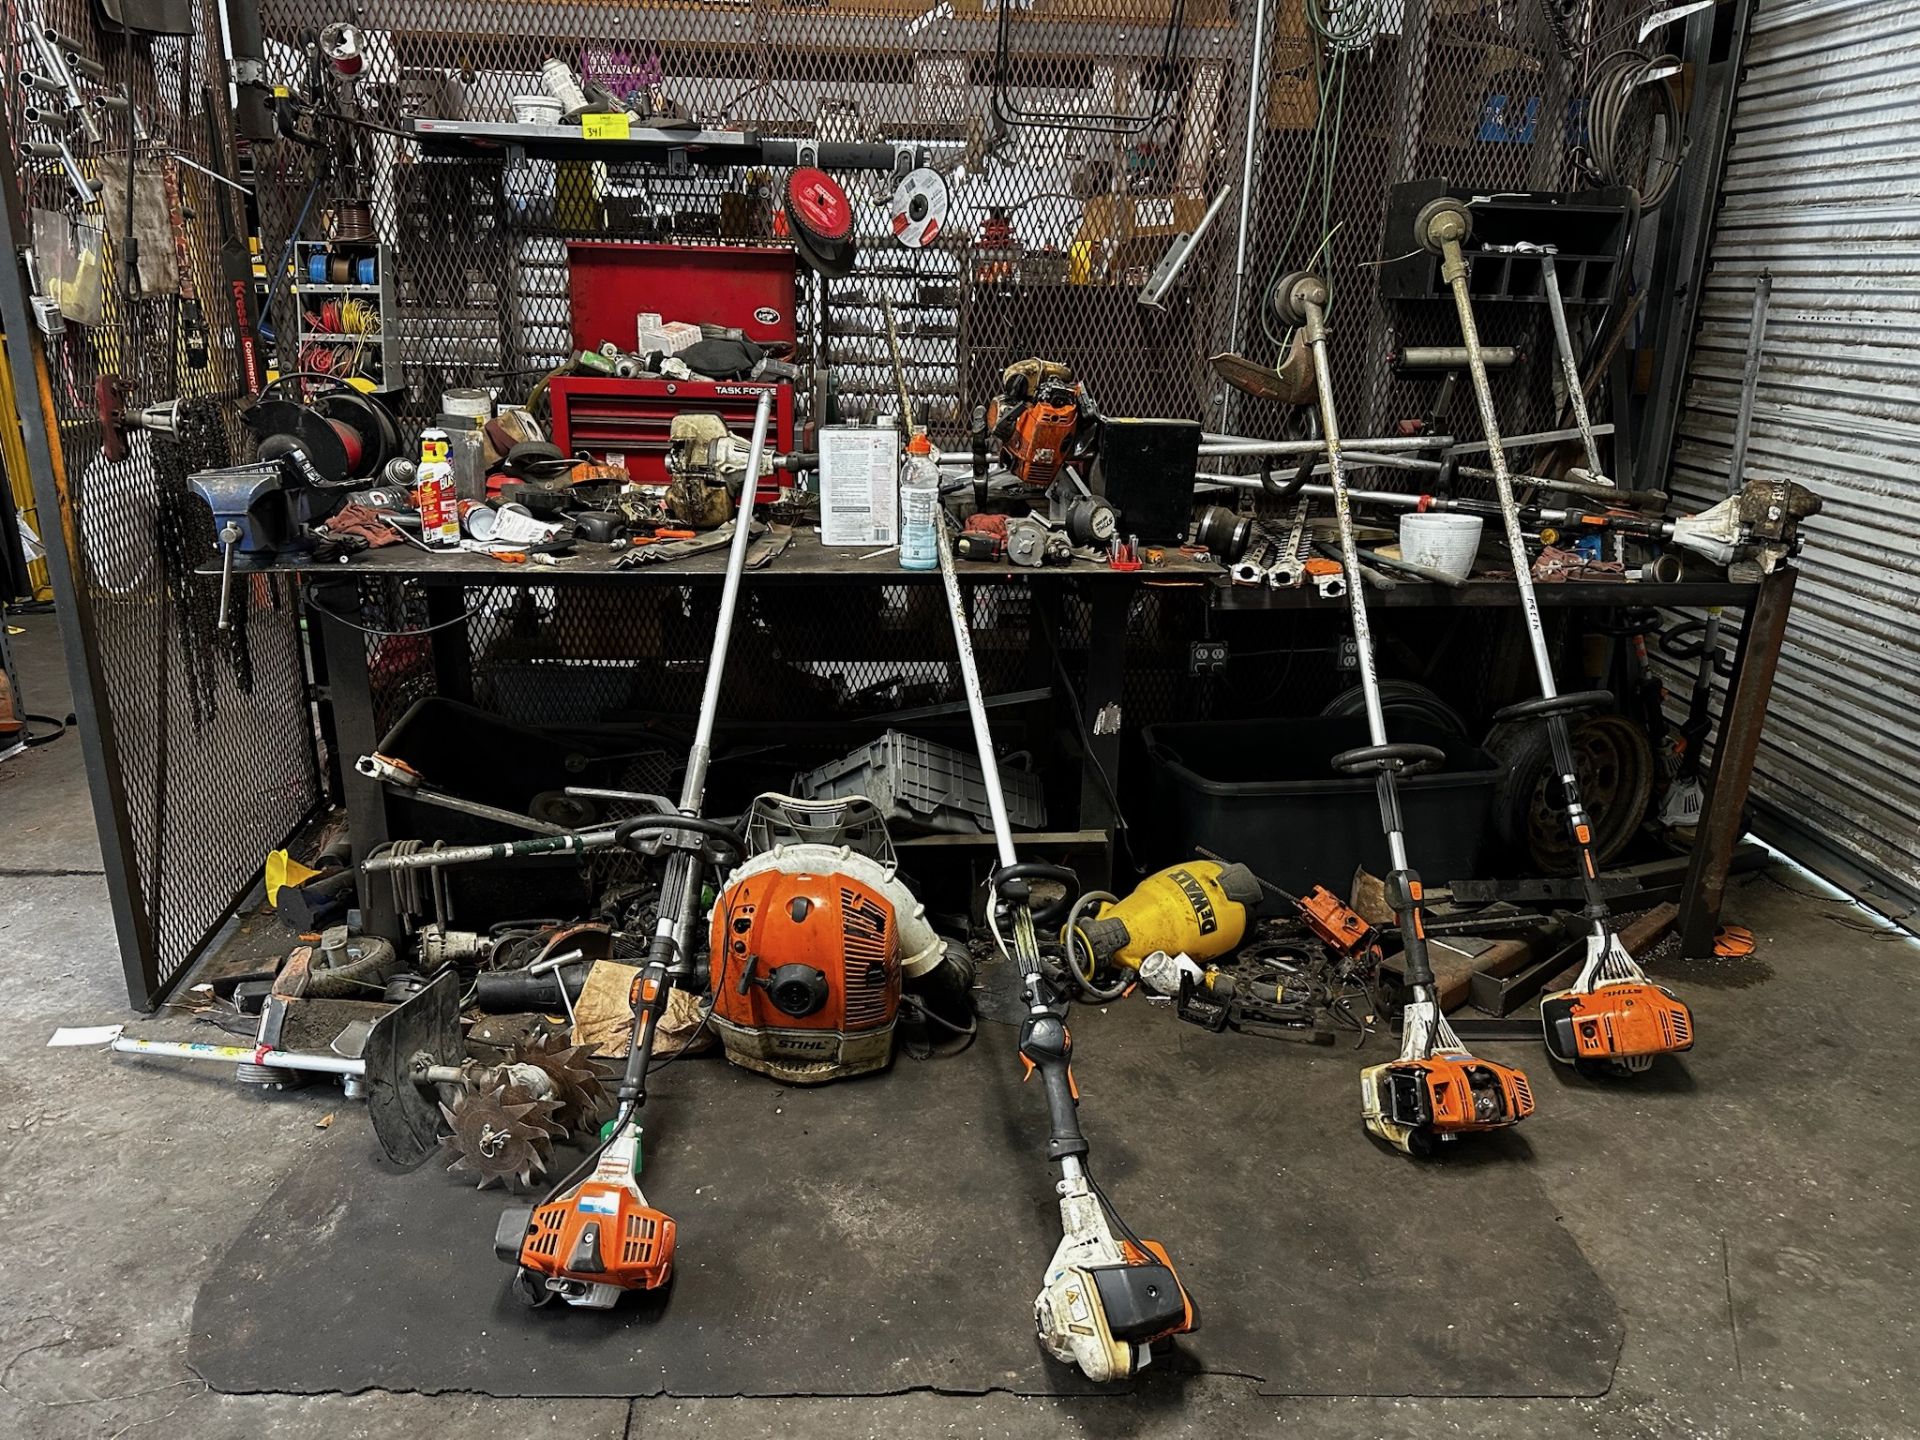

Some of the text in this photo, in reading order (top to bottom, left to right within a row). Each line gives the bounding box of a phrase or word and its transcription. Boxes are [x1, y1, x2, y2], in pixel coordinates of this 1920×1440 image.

[232, 280, 249, 327] Kress
[244, 340, 259, 396] Commercia
[715, 386, 777, 396] TASK FORE
[1169, 868, 1217, 936] DEWALT
[1602, 989, 1643, 998] STIHL
[776, 1040, 826, 1050] STIHL
